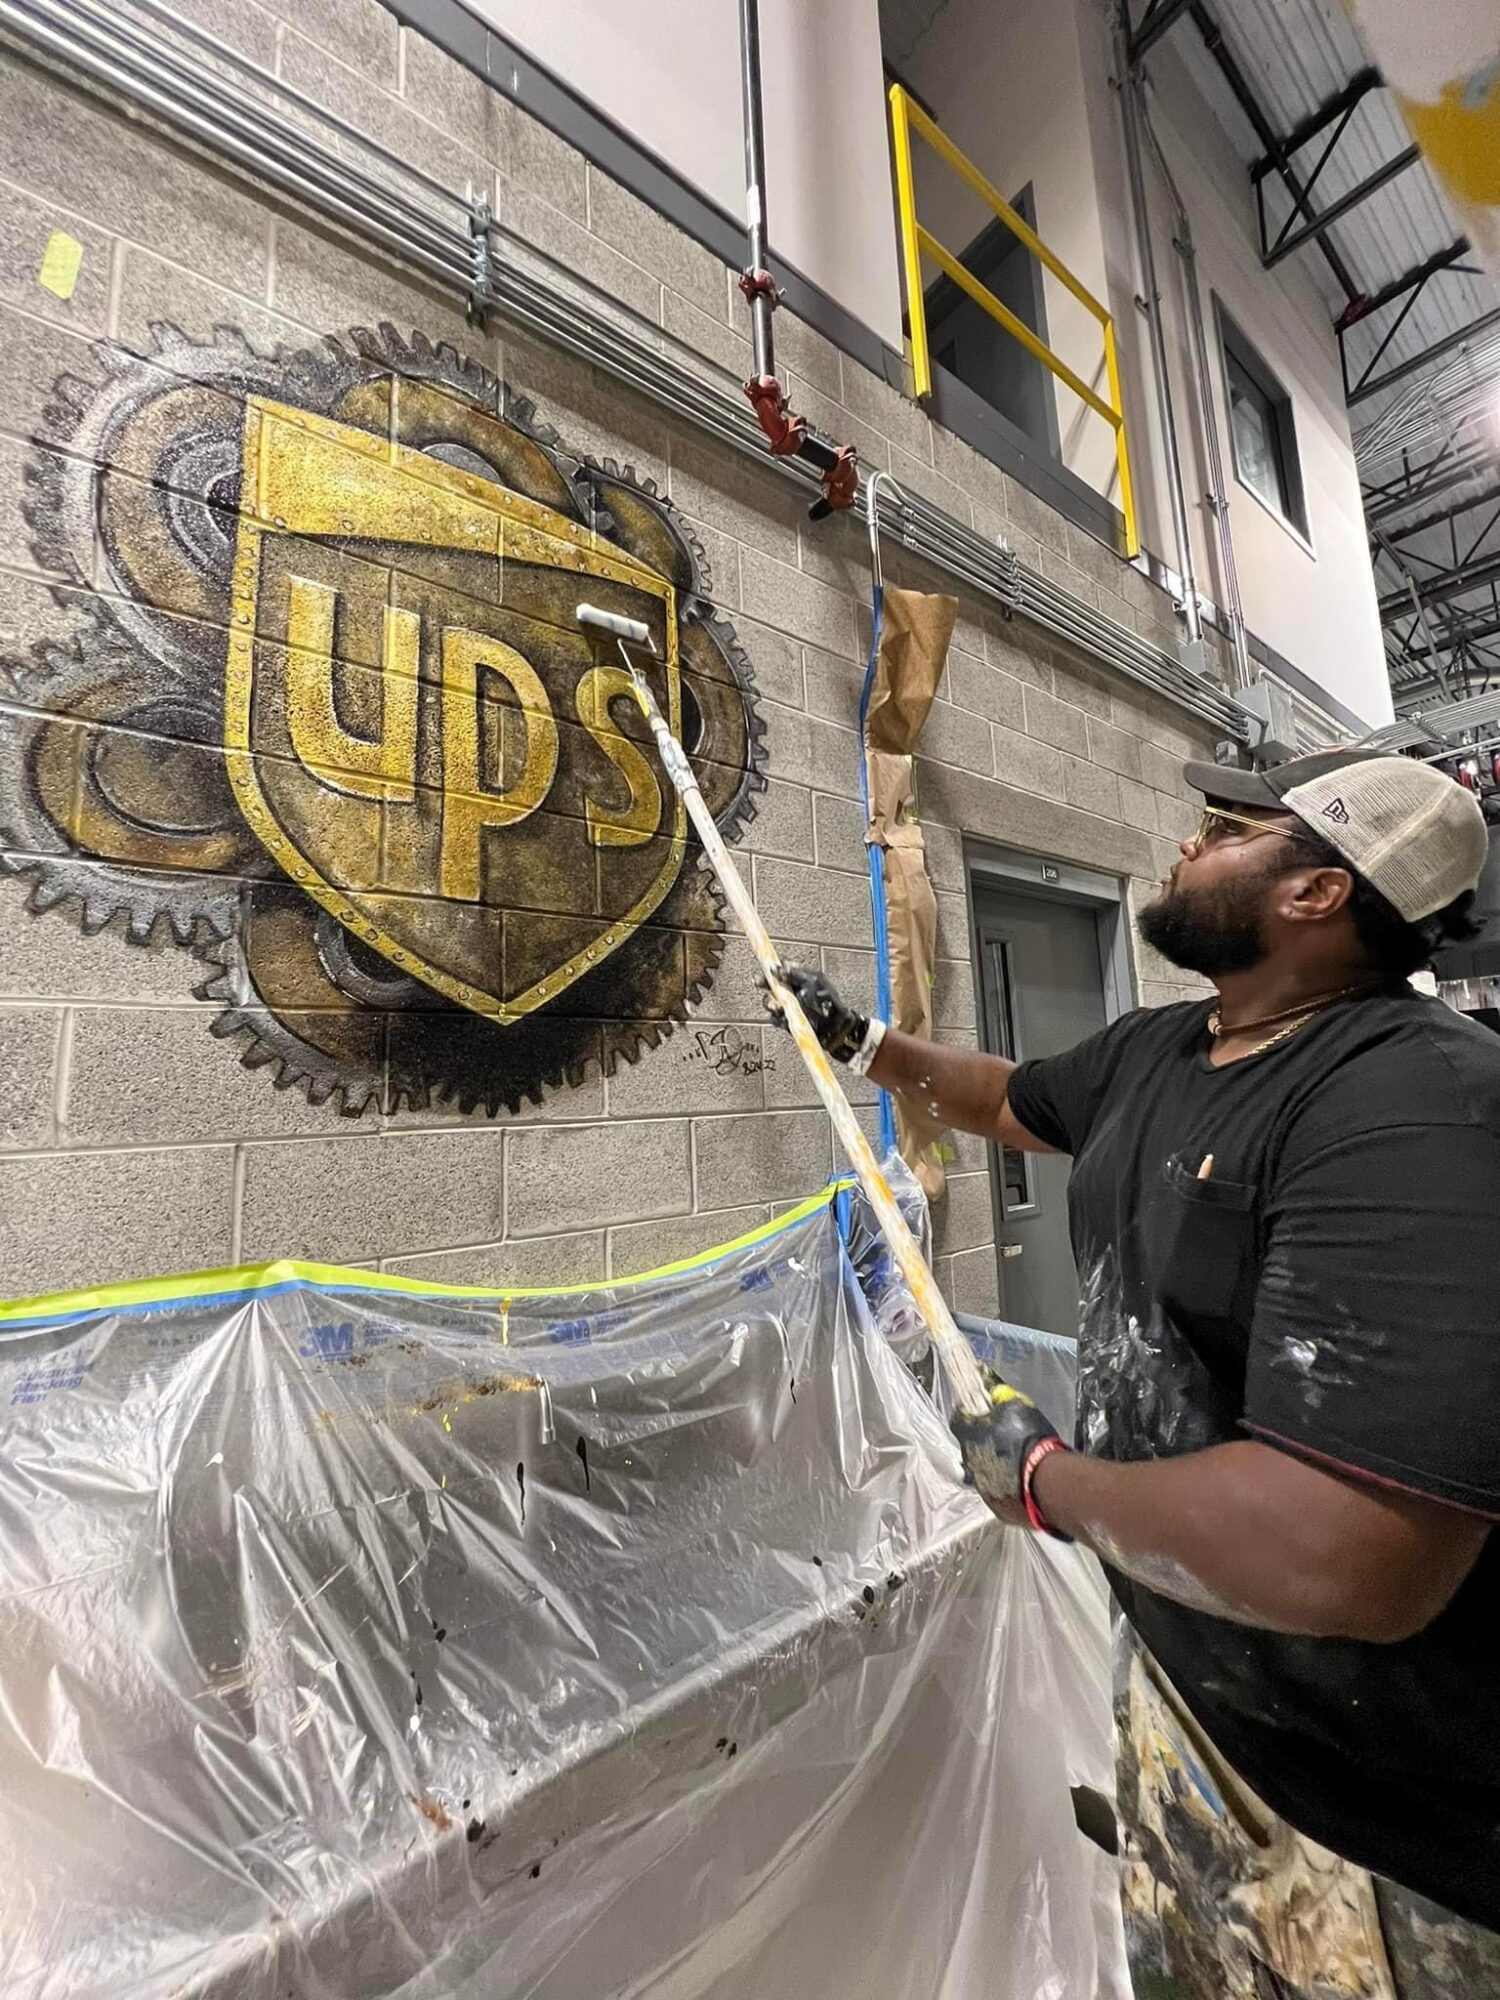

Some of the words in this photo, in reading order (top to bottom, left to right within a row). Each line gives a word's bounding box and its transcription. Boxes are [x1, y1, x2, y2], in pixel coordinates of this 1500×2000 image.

[298, 1322, 354, 1357] 3M
[13, 1376, 84, 1395] Masking
[10, 1393, 48, 1406] Film
